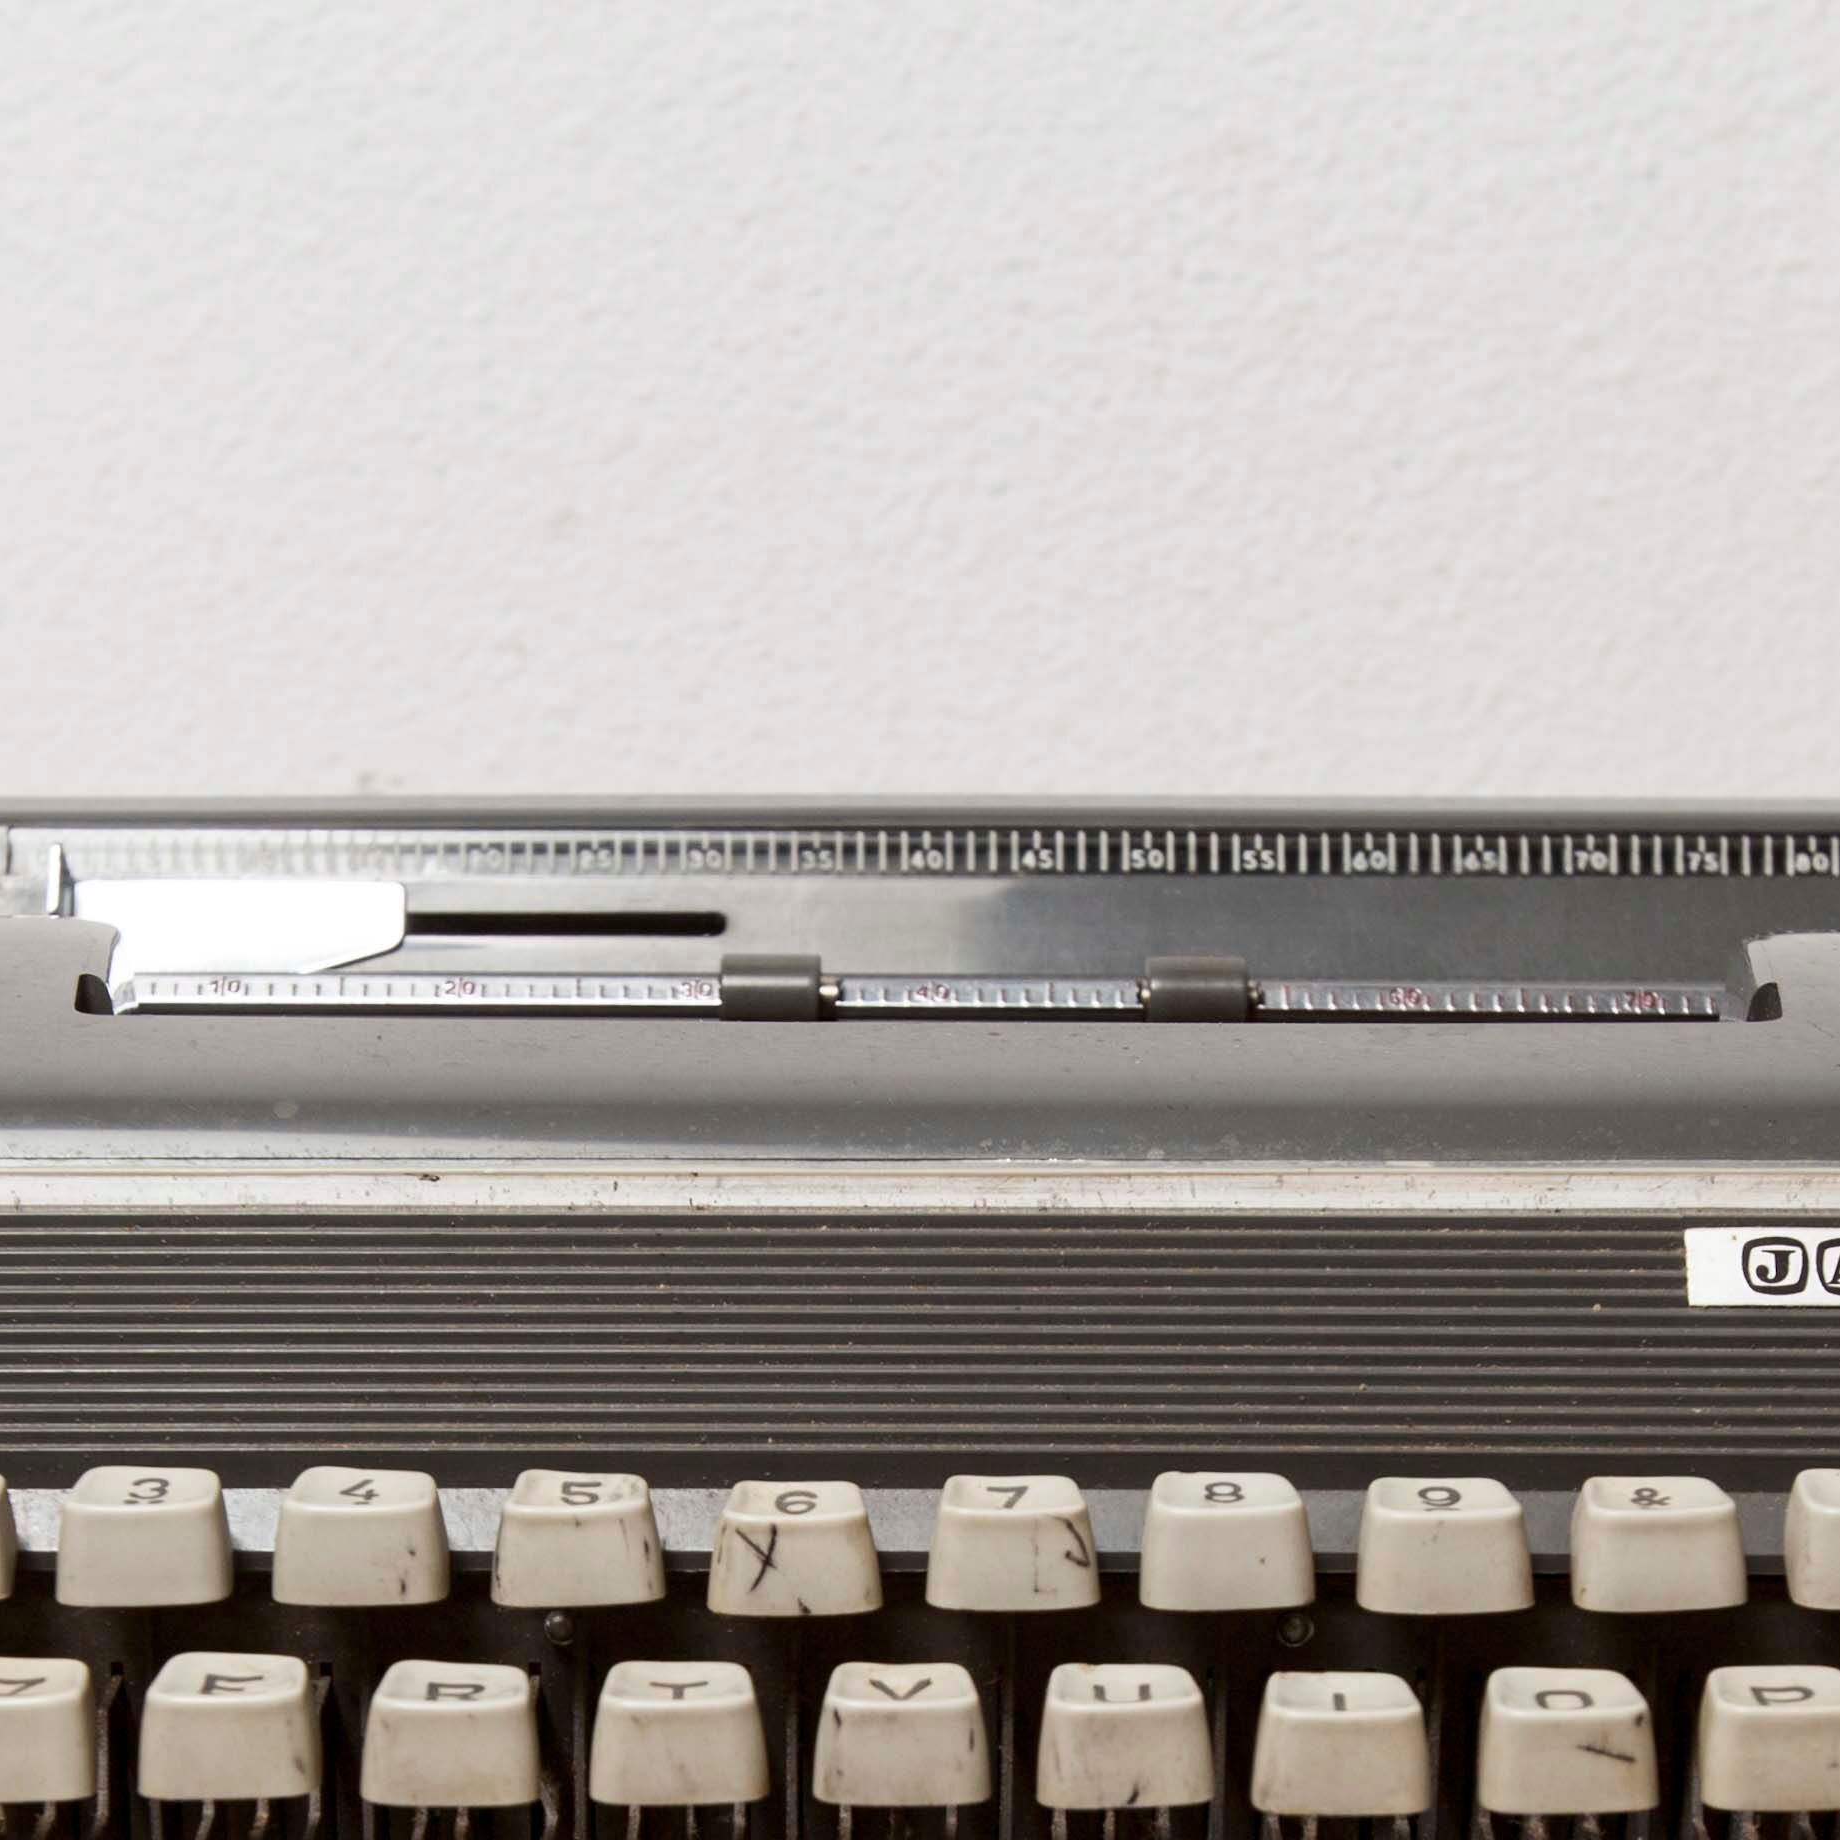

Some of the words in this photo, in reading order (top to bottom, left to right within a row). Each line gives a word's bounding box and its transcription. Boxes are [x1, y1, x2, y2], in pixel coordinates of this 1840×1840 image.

[687, 850, 722, 870] 30
[801, 850, 834, 870] 35
[910, 850, 944, 870] 40
[1022, 850, 1054, 870] 45
[1131, 850, 1165, 870] 50
[1242, 850, 1276, 870] 55
[1352, 851, 1388, 871] 60
[1463, 851, 1499, 871] 65
[1574, 852, 1609, 871] 70
[1687, 852, 1720, 872] 75
[1794, 853, 1830, 873] 80
[444, 979, 475, 996] 20
[127, 1477, 170, 1499] 3
[339, 1479, 380, 1501] 4
[560, 1481, 603, 1506] 5
[986, 1485, 1029, 1509] 7
[1204, 1481, 1245, 1504] 8
[1417, 1486, 1462, 1508] 9
[774, 1490, 818, 1516] 6
[425, 1682, 486, 1701] R
[649, 1680, 709, 1700] T
[1534, 1690, 1594, 1709] O
[1750, 1686, 1815, 1706] P
